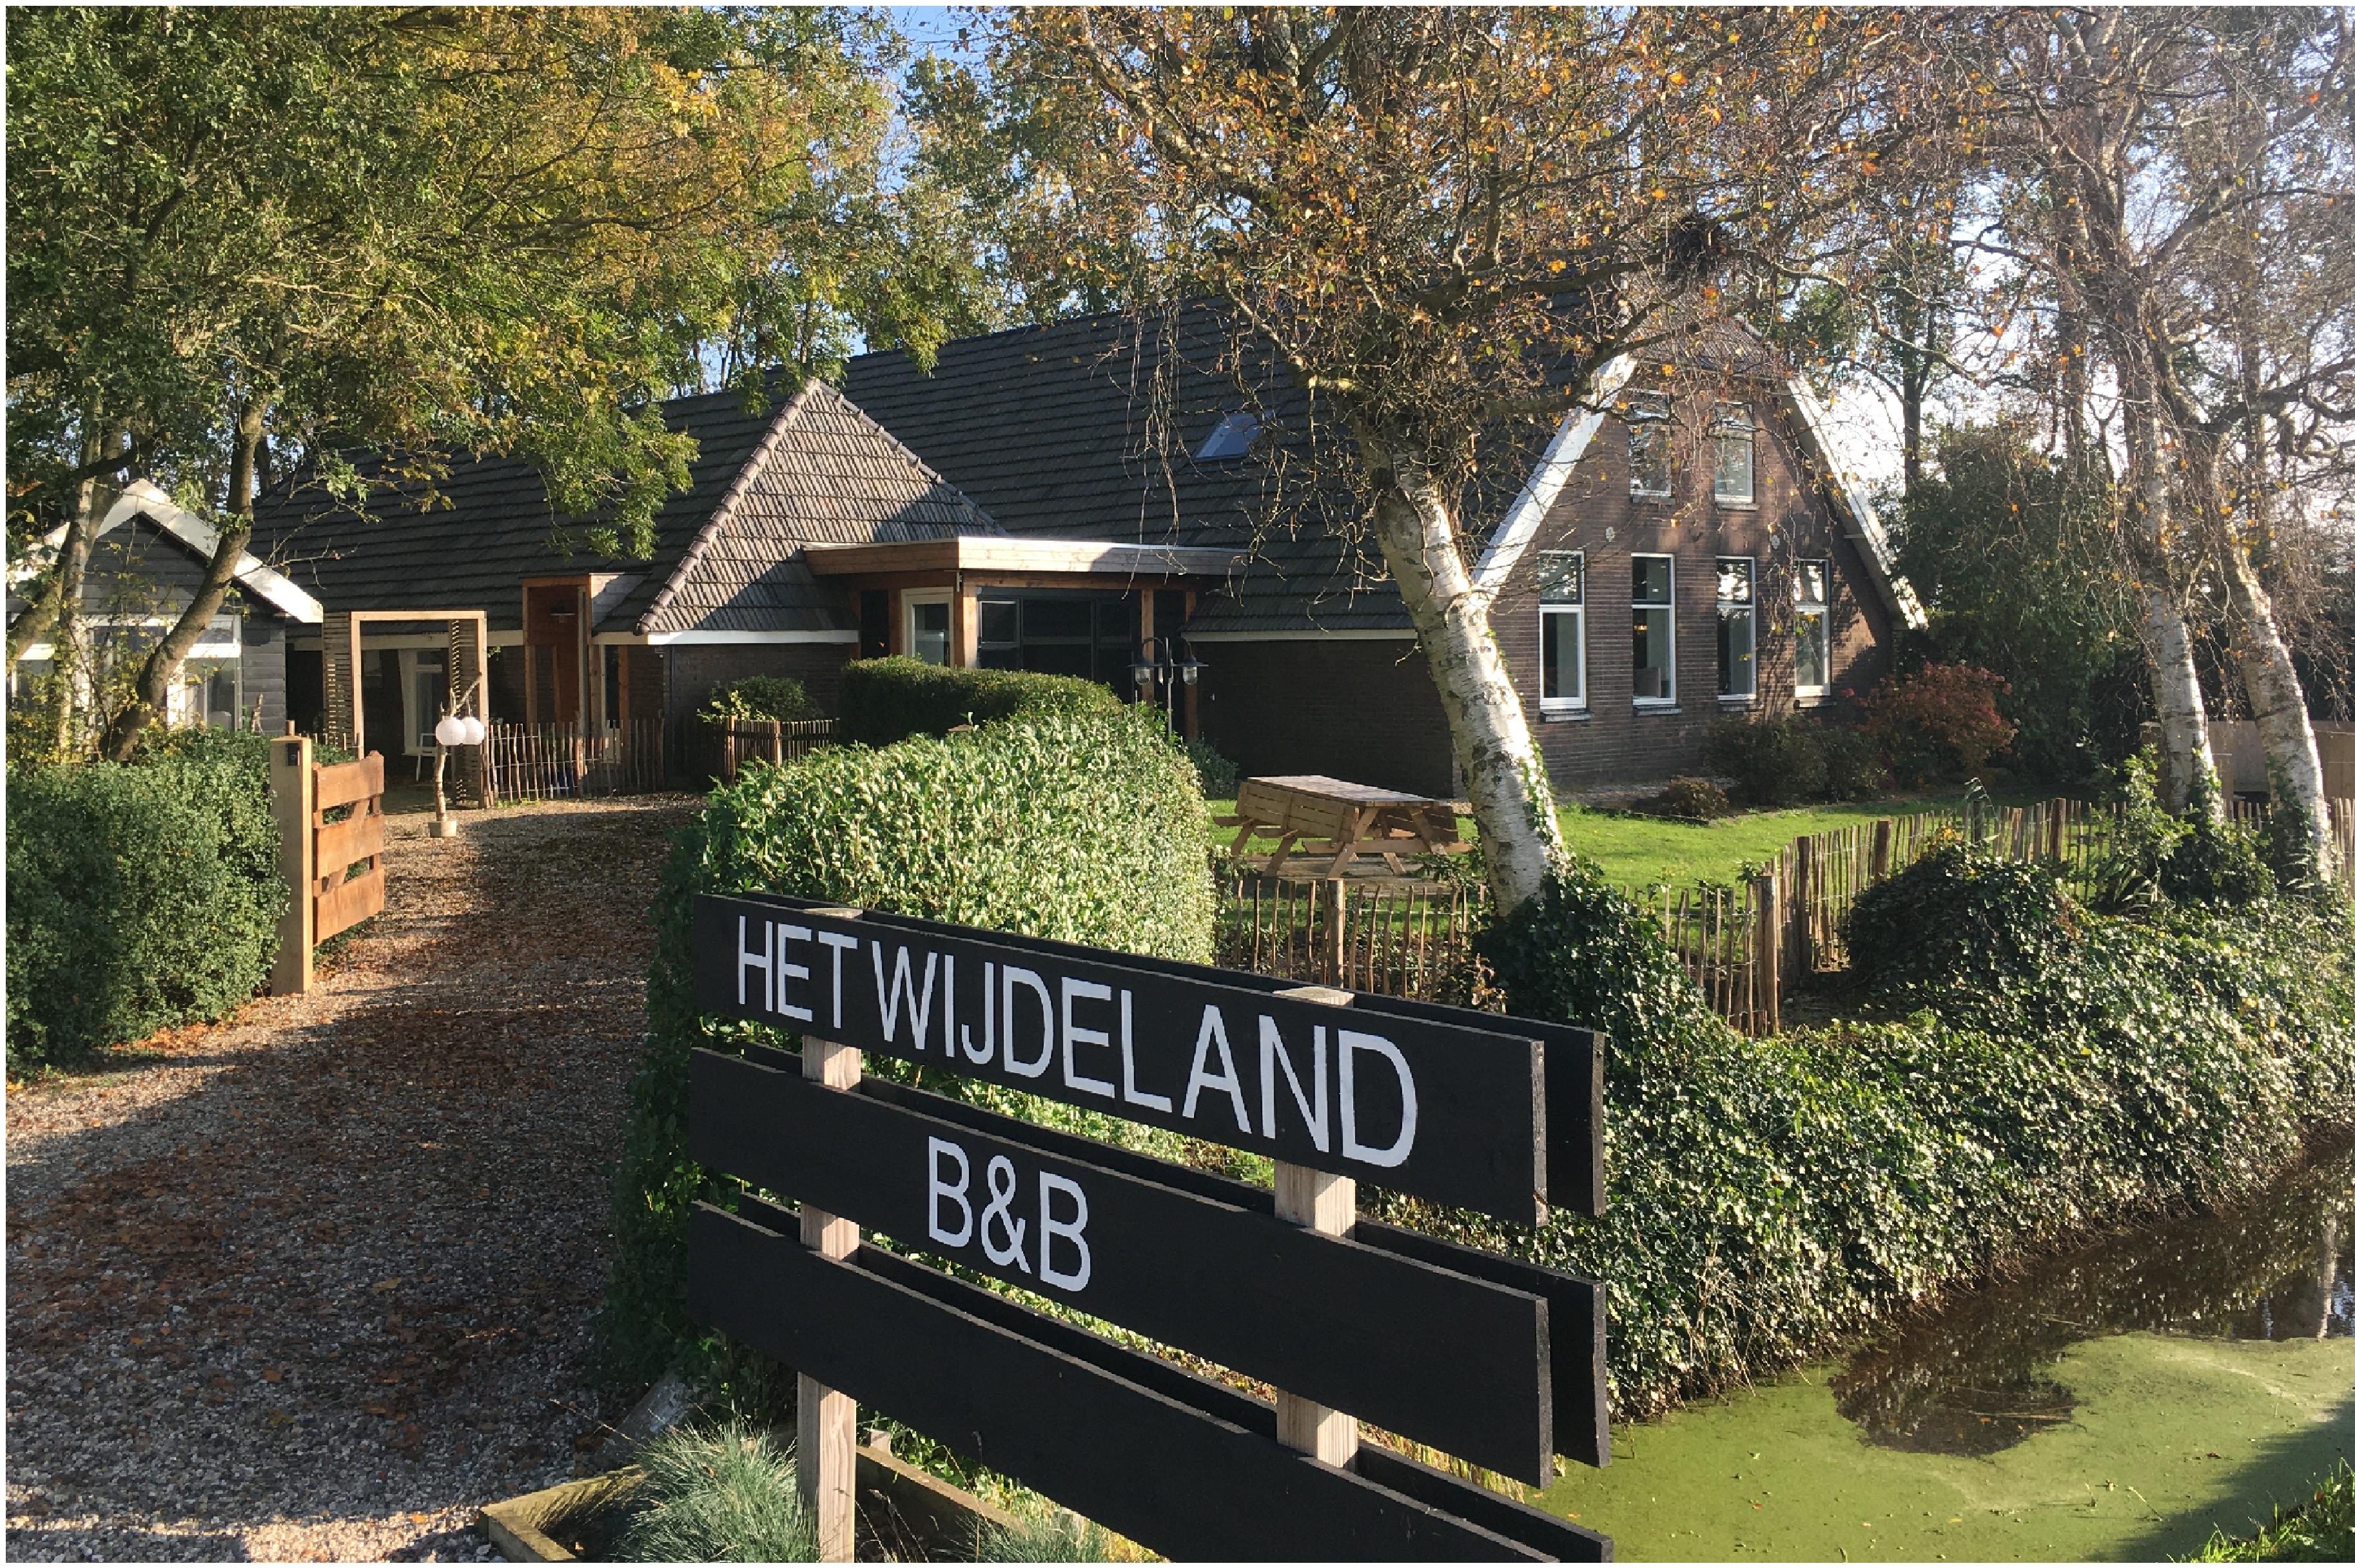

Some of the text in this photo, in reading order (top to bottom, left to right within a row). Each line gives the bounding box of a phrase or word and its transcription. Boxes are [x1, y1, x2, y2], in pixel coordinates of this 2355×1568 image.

[738, 915, 1417, 1168] HET WIJDELAND
[928, 1136, 1091, 1292] B&B
